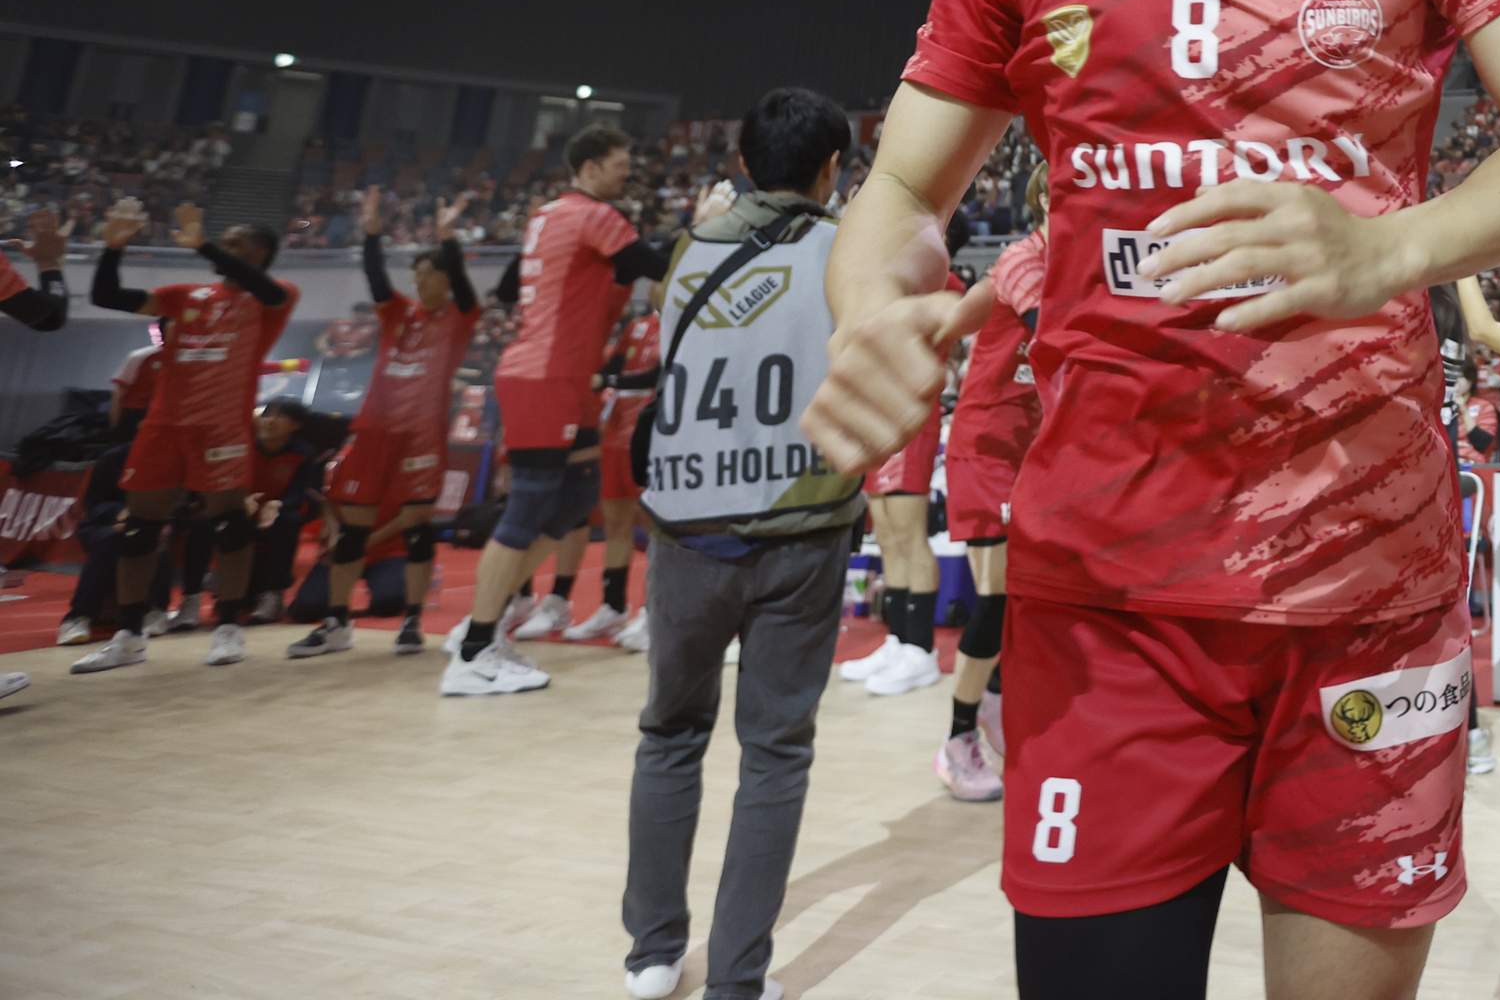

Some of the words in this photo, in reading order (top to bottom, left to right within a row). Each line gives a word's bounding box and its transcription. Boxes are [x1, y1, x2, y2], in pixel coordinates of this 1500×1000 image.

[1305, 8, 1378, 37] SUNBIRDS
[1070, 132, 1371, 190] SUNTORY
[728, 275, 779, 321] LEAGUE
[656, 353, 794, 437] 040
[716, 442, 838, 487] HOLDE
[1384, 670, 1471, 719] つの食品
[1032, 777, 1081, 863] 8
